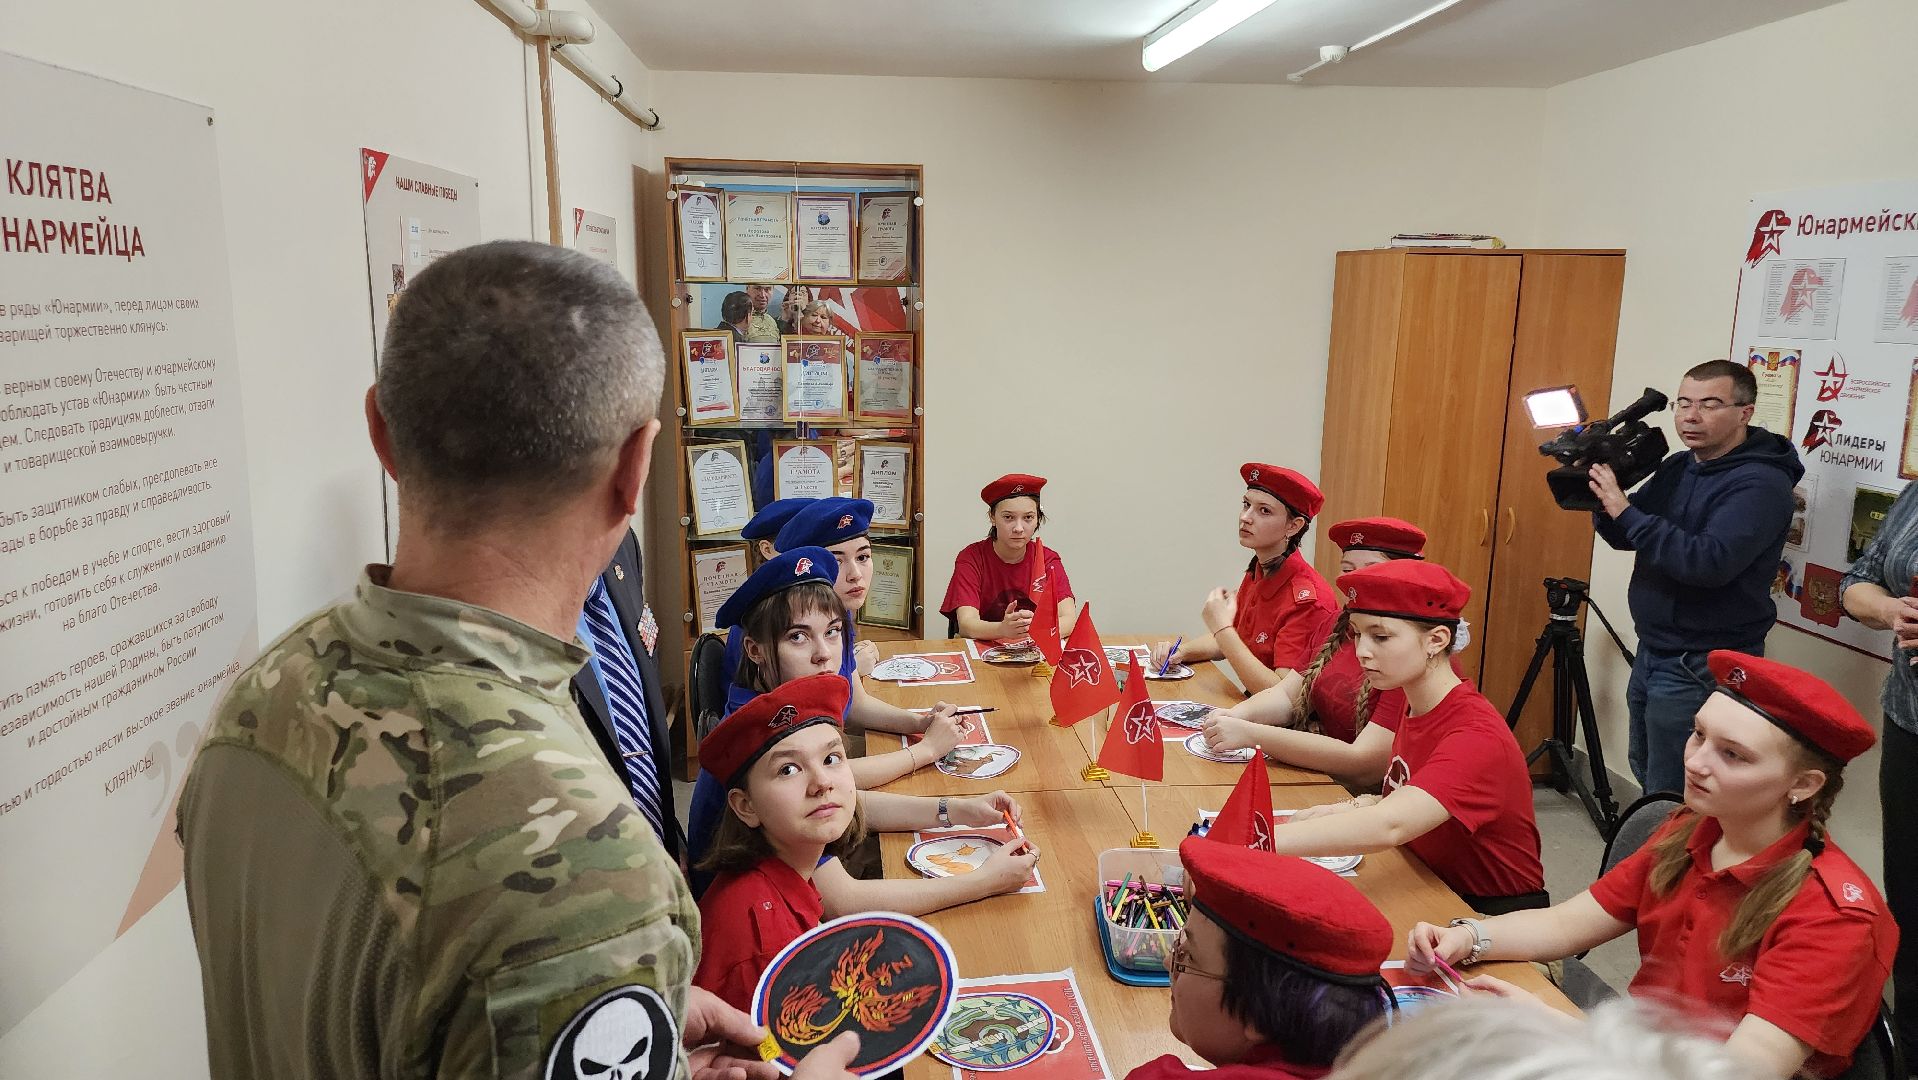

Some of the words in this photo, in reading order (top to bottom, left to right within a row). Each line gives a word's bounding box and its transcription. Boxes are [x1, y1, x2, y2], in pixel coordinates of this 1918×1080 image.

[6, 158, 113, 204] КЛЯТВА
[395, 176, 414, 192] НАШИ
[414, 181, 439, 198] СЛАВНЫЕ
[440, 186, 459, 202] ПОБЕДЫ
[1, 216, 146, 263] НАРМЕЙЦА
[10, 304, 41, 320] ряды
[115, 300, 144, 315] перед
[146, 299, 173, 312] лицом
[176, 299, 200, 310] своих
[55, 324, 128, 341] торжественно
[130, 322, 169, 335] клянусь:
[4, 378, 51, 398] верным
[55, 373, 93, 387] своему
[95, 367, 144, 381] Отечеству
[147, 366, 153, 376] и
[154, 358, 216, 376] юнармейскому
[60, 397, 90, 416] устав
[155, 383, 177, 397] быть
[178, 379, 214, 392] честным
[25, 422, 85, 443] Следовать
[89, 411, 142, 434] традициям
[144, 404, 187, 422] доблести,
[188, 398, 215, 413] отваги
[1835, 433, 1887, 452] ЛИДЕРЫ
[4, 462, 12, 473] и
[14, 440, 97, 470] товарищеской
[1820, 450, 1884, 473] ЮНАРМИИ
[0, 511, 29, 528] быть
[31, 489, 100, 518] защитником
[102, 478, 141, 498] слабых,
[142, 463, 203, 490] преодолевать
[203, 458, 218, 470] все
[29, 533, 36, 545] в
[39, 517, 79, 541] борьбе
[81, 515, 93, 529] за
[95, 504, 131, 526] правду
[132, 502, 139, 513] и
[22, 585, 29, 598] к
[31, 574, 80, 594] победам
[82, 564, 89, 576] в
[91, 551, 120, 575] учебе
[123, 549, 129, 561] и
[131, 538, 165, 557] спорте,
[166, 527, 191, 544] вести
[192, 510, 231, 535] здоровый
[44, 587, 92, 614] готовить
[93, 575, 117, 594] себя
[119, 573, 126, 585] к
[127, 554, 173, 581] служению
[174, 551, 181, 563] и
[182, 534, 226, 559] созиданию
[62, 617, 76, 632] на
[78, 603, 107, 624] благо
[109, 582, 161, 611] Отечества.
[25, 671, 67, 698] память
[69, 651, 108, 676] героев,
[110, 617, 173, 658] сражавшихся
[175, 612, 185, 625] за
[186, 596, 219, 619] свободу
[84, 665, 118, 693] нашей
[119, 648, 159, 674] Родины,
[161, 635, 182, 653] быть
[183, 612, 225, 641] патриотом
[27, 736, 36, 748] и
[39, 700, 99, 746] достойным
[102, 664, 165, 709] гражданином
[166, 646, 198, 671] России
[24, 787, 33, 801] и
[35, 750, 93, 794] гордостью
[95, 732, 124, 757] нести
[126, 707, 164, 739] высокое
[166, 688, 196, 714] звание
[104, 753, 154, 797] КЛЯНУСЬ!
